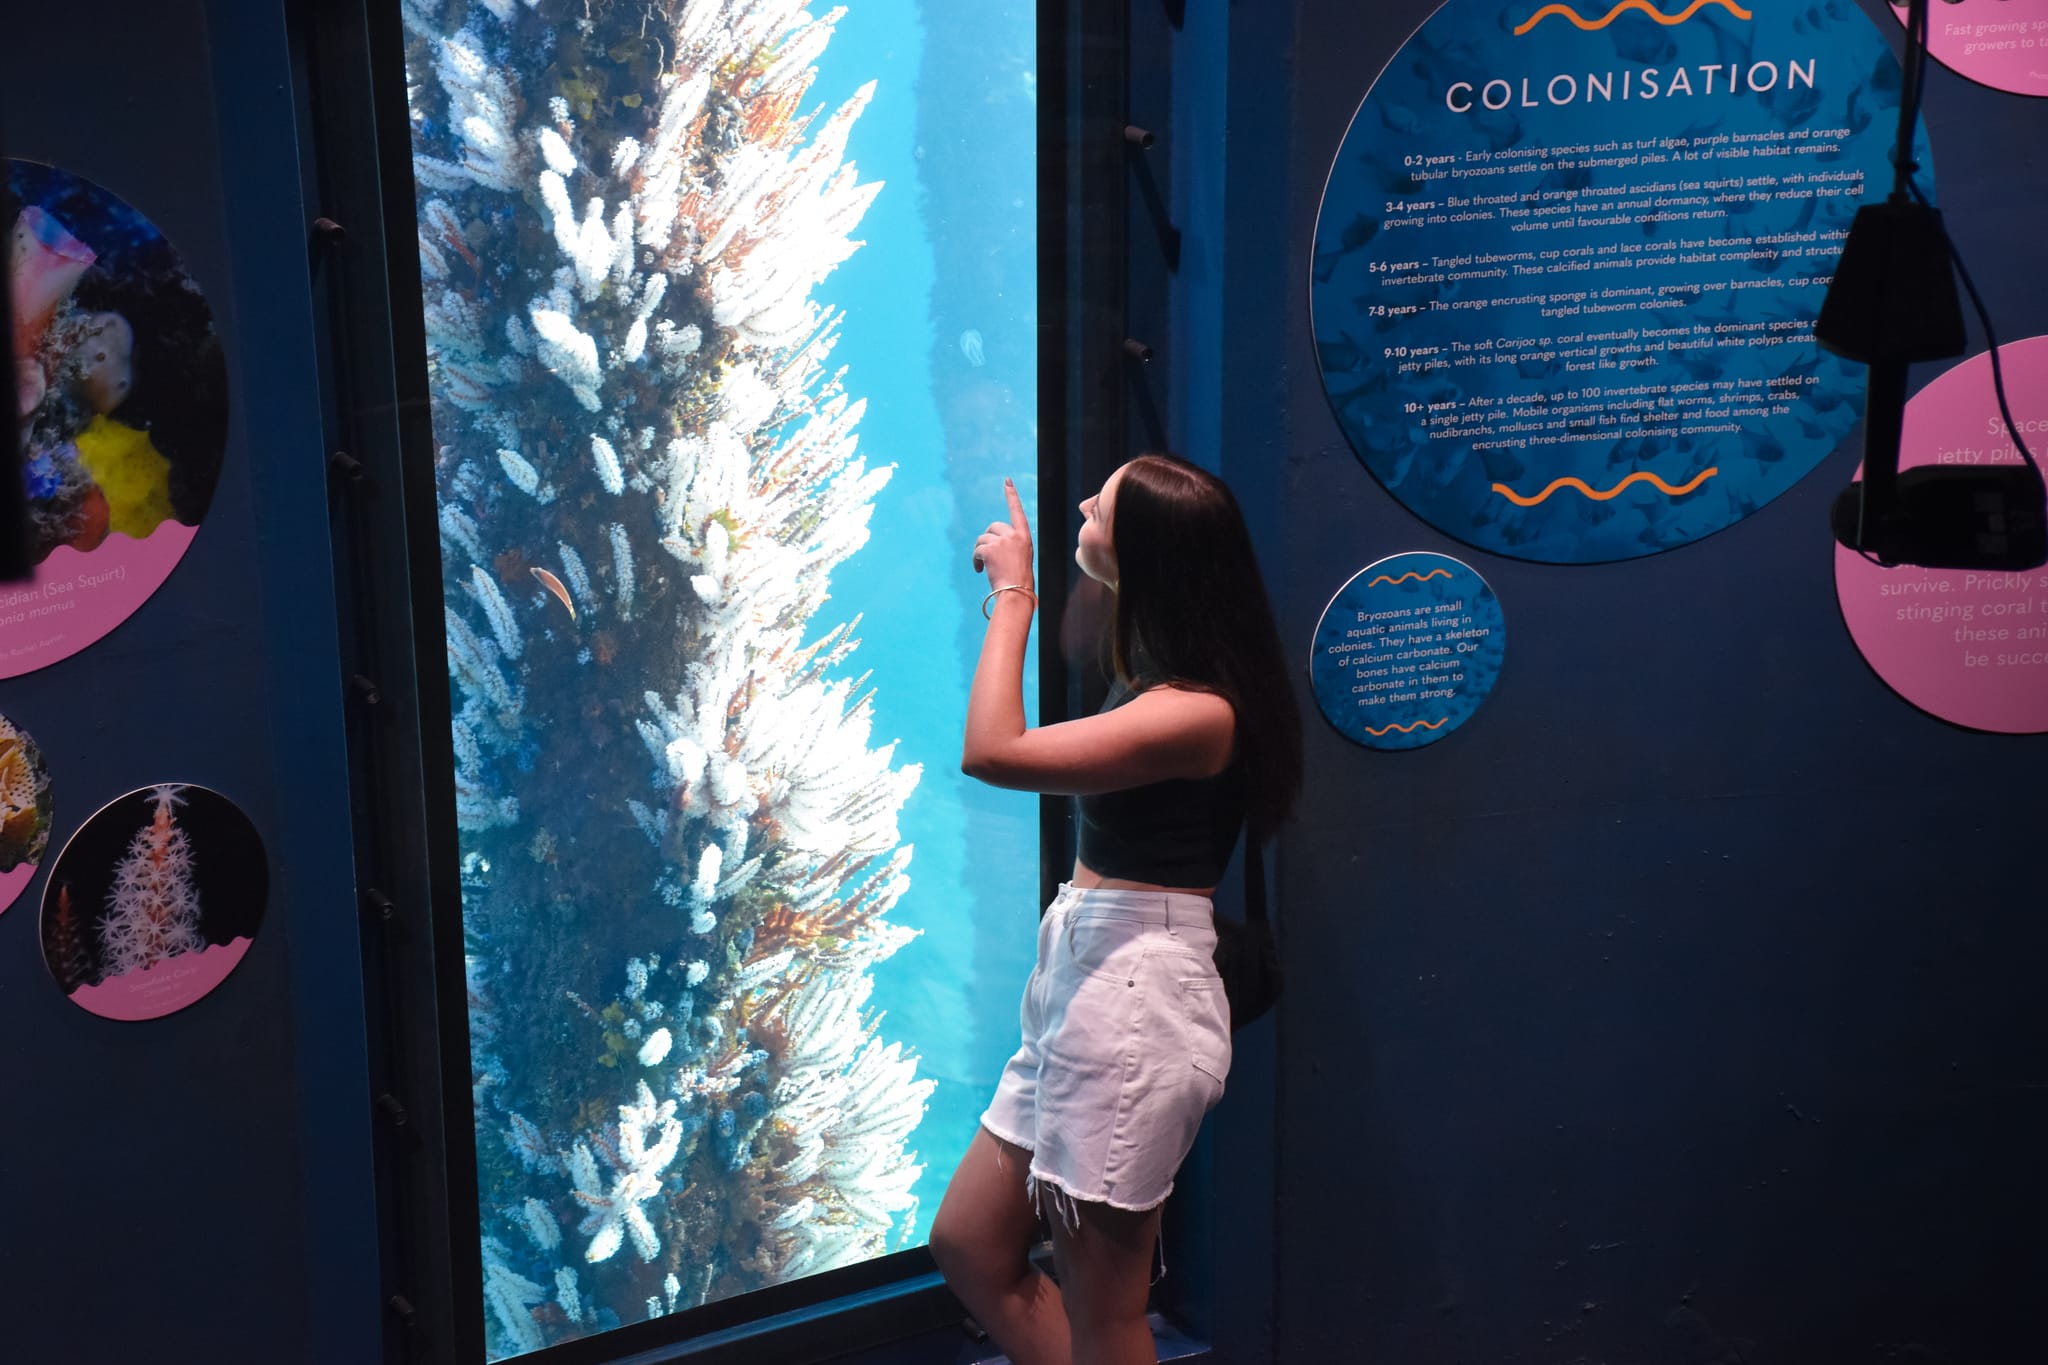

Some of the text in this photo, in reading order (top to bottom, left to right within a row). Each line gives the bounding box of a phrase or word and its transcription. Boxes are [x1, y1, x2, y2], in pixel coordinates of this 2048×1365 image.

[1944, 23, 1972, 36] Fast
[1975, 20, 2028, 37] growing
[1964, 40, 2017, 55] growers
[2021, 38, 2035, 49] to
[1446, 58, 1815, 112] COLONISATION
[1403, 155, 1423, 165] 0-2
[1424, 155, 1455, 166] years
[1465, 150, 1492, 162] Early
[1493, 146, 1548, 158] colonising
[1550, 143, 1590, 157] species
[1592, 140, 1618, 151] such
[1635, 137, 1657, 149] turf
[1658, 137, 1689, 149] algae,
[1692, 133, 1729, 147] purple
[1731, 130, 1785, 142] barnacles
[1787, 128, 1809, 139] and
[1811, 129, 1850, 139] orange
[1410, 169, 1448, 181] tubular
[1451, 167, 1505, 179] bryozoans
[1507, 162, 1537, 173] settle
[1557, 159, 1575, 169] the
[1577, 154, 1638, 168] submerged
[1640, 153, 1668, 166] piles.
[1671, 151, 1681, 161] A
[1683, 150, 1699, 160] lot
[1701, 148, 1714, 159] of
[1715, 147, 1750, 158] visible
[1752, 146, 1791, 156] habitat
[1793, 143, 1840, 154] remains.
[1385, 169, 1864, 213] 3-4 years Blue throated and orange throated ascidians (sea squirts) settle, with individuals
[1510, 210, 1728, 232] volume until favourable conditions return.
[1368, 261, 1387, 272] 5-6
[1389, 261, 1419, 273] years
[1430, 254, 1472, 268] Tangled
[1474, 252, 1536, 263] tubeworms,
[1539, 250, 1560, 260] cup
[1562, 245, 1594, 256] corals
[1596, 243, 1617, 254] and
[1620, 243, 1642, 252] lace
[1644, 240, 1677, 251] corals
[1679, 239, 1705, 248] have
[1707, 237, 1752, 246] become
[1754, 230, 1817, 243] established
[1381, 246, 1844, 286] invertebrate community. These calcified animals provide habitat complexity and structu
[1540, 298, 1686, 318] tangled tubeworm colonies.
[1383, 347, 1407, 357] 9-10
[1409, 347, 1439, 357] years
[1449, 342, 1471, 351] The
[1473, 339, 1493, 349] soft
[1495, 337, 1536, 349] Carijoa
[1538, 337, 1552, 347] sp.
[1556, 332, 1584, 343] coral
[1585, 328, 1639, 341] eventually
[1641, 328, 1690, 337] becomes
[1692, 324, 1711, 334] the
[1713, 322, 1765, 333] dominant
[1768, 319, 1808, 331] species
[1565, 356, 1659, 371] forest like growth.
[1403, 402, 1424, 412] 10+
[1427, 402, 1457, 413] years
[1467, 396, 1495, 407] After
[1505, 392, 1547, 403] decade,
[1550, 393, 1565, 402] up
[1567, 390, 1579, 399] to
[1581, 387, 1601, 398] 100
[1603, 384, 1667, 396] invertebrate
[1670, 381, 1709, 394] species
[1712, 382, 1736, 390] may
[1737, 378, 1763, 387] have
[1765, 375, 1802, 386] settled
[1471, 423, 1742, 450] encrusting three-dimensional colonising community.
[1937, 447, 1983, 464] jetty
[43, 582, 73, 599] (Sea
[78, 566, 125, 588] Squirt)
[1880, 576, 1956, 596] survive.
[1965, 572, 2032, 592] Prickly
[29, 600, 75, 619] momus
[1357, 600, 1462, 622] Bryozoans are small
[1896, 601, 1975, 623] stinging
[1981, 597, 2033, 616] coral
[1346, 614, 1471, 640] aquatic animals living in
[1954, 625, 2009, 642] these
[1327, 641, 1375, 653] colonies.
[1378, 637, 1405, 647] They
[1408, 635, 1432, 644] have
[1445, 629, 1489, 640] skeleton
[1337, 642, 1479, 666] of calcium carbonate. Our
[1964, 651, 1989, 667] be
[1356, 660, 1460, 678] bones have calcium
[1351, 673, 1464, 694] carbonate in them to
[1357, 689, 1456, 706] make them strong.
